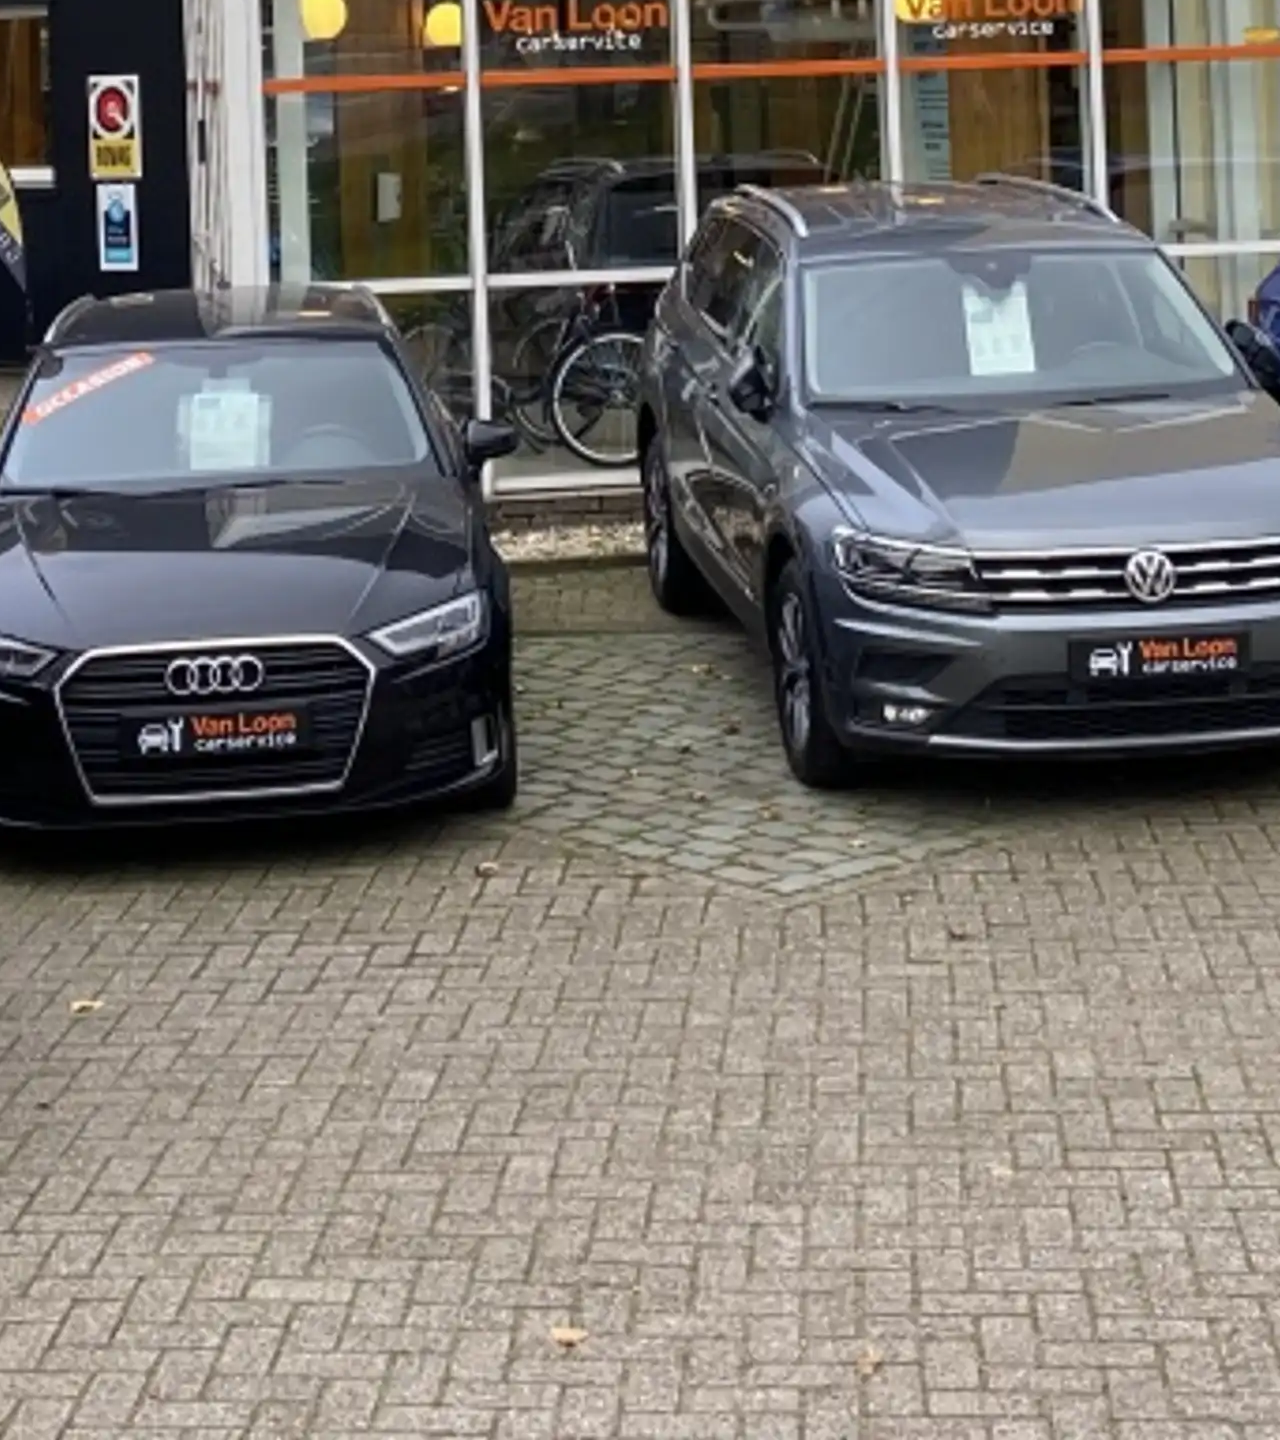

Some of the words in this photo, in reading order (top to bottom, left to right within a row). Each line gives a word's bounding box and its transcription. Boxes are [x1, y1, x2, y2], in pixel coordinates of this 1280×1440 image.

[932, 21, 1054, 39] carservice
[515, 30, 642, 53] carservice
[1139, 639, 1179, 658] Van
[1184, 637, 1238, 658] Loon
[189, 715, 233, 735] Van
[239, 712, 297, 733] Loon
[194, 732, 297, 751] carservice
